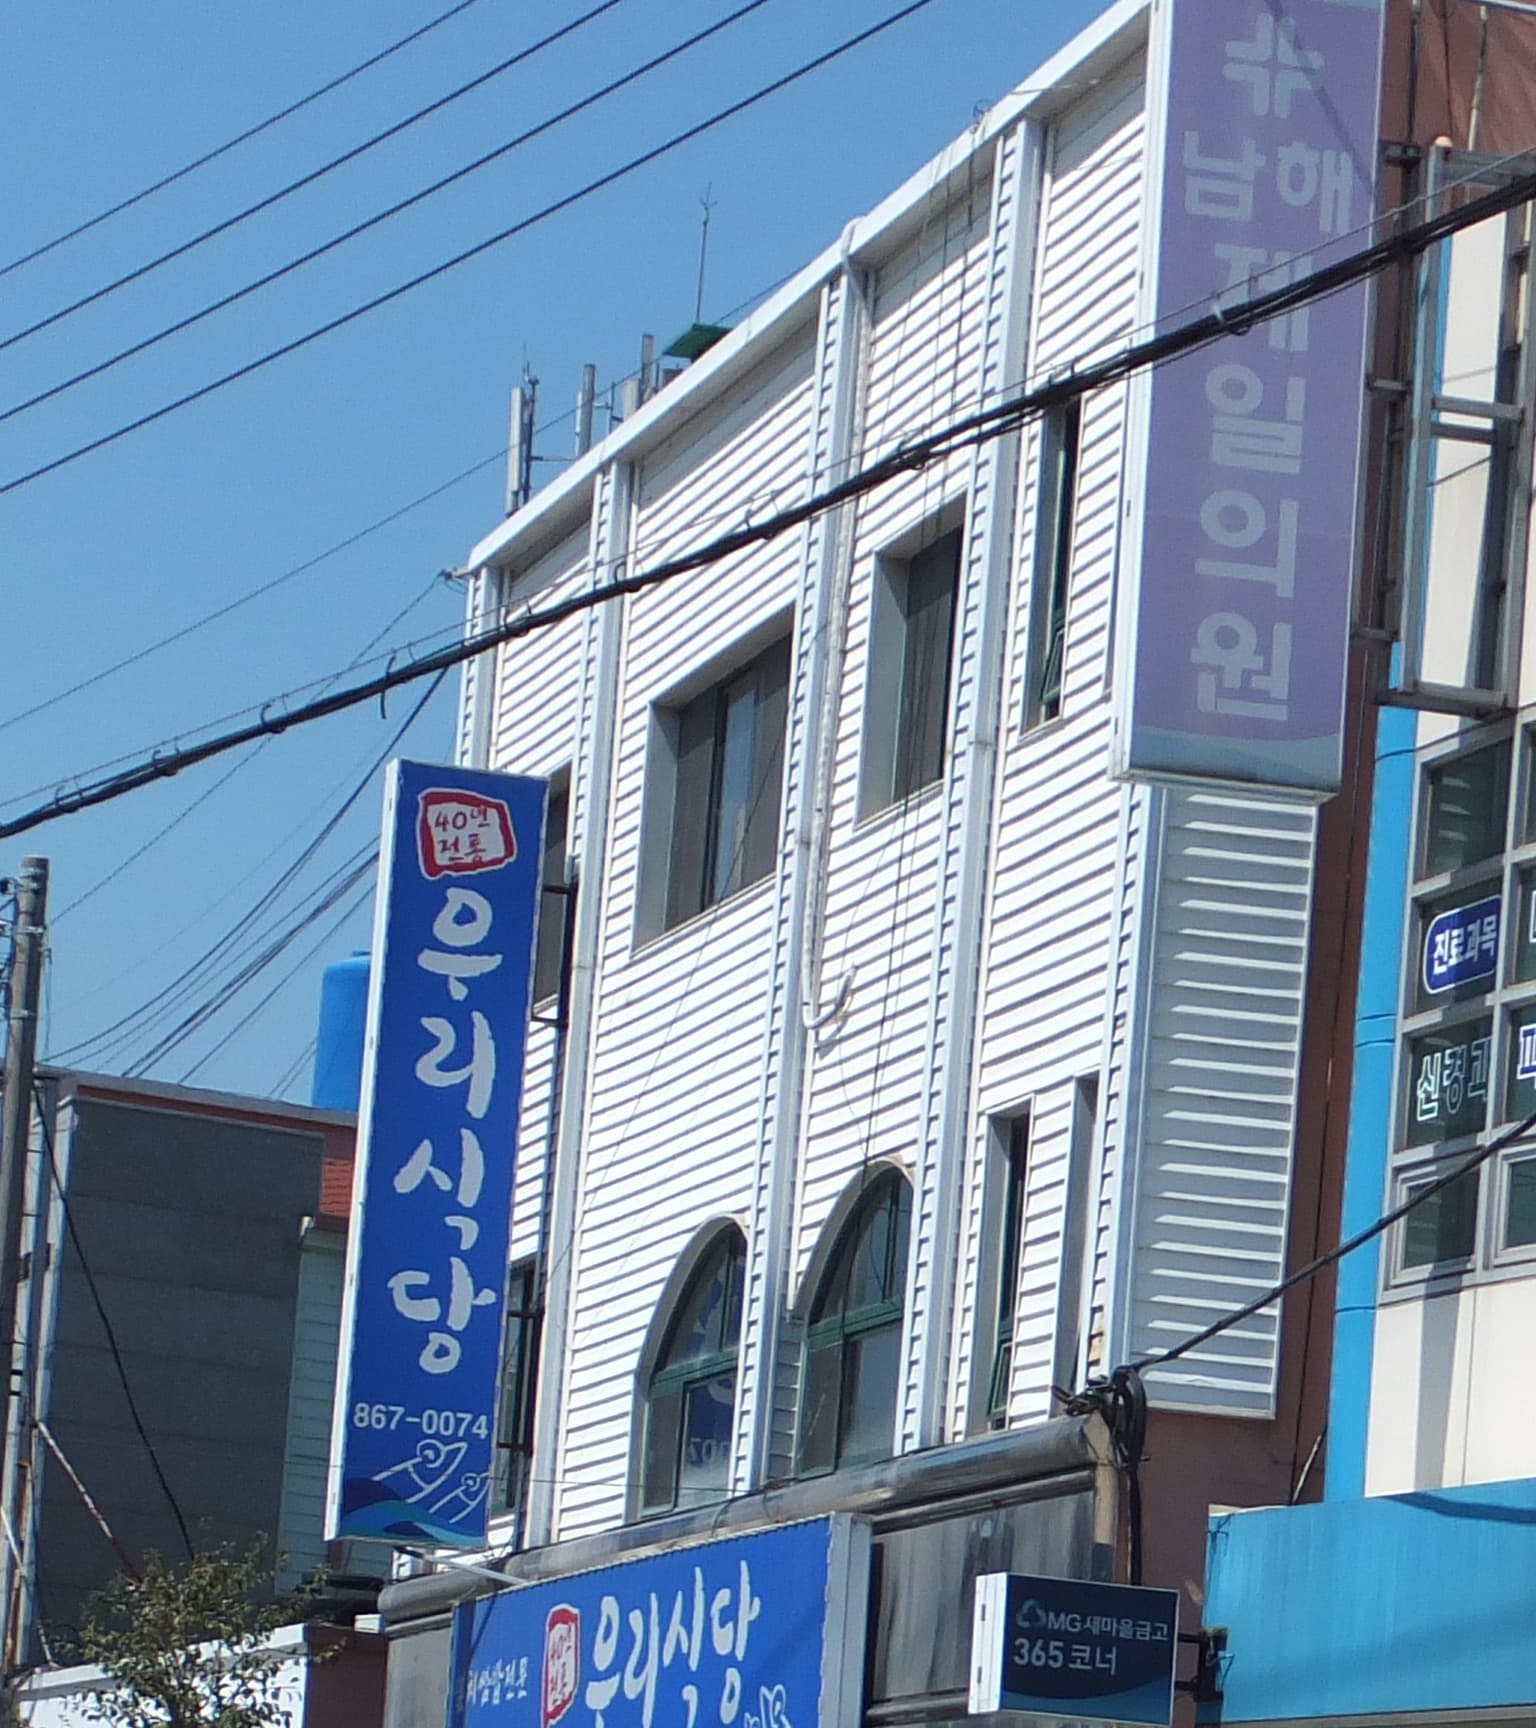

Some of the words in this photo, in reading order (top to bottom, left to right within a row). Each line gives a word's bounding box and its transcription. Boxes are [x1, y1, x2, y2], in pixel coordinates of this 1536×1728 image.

[434, 806, 491, 832] 40년
[437, 833, 486, 863] 전통
[1432, 914, 1498, 976] 진료과목
[387, 886, 503, 1375] 우리식당
[352, 1403, 490, 1440] 867-0074
[1013, 1637, 1064, 1669] 365
[1068, 1643, 1117, 1677] 코너
